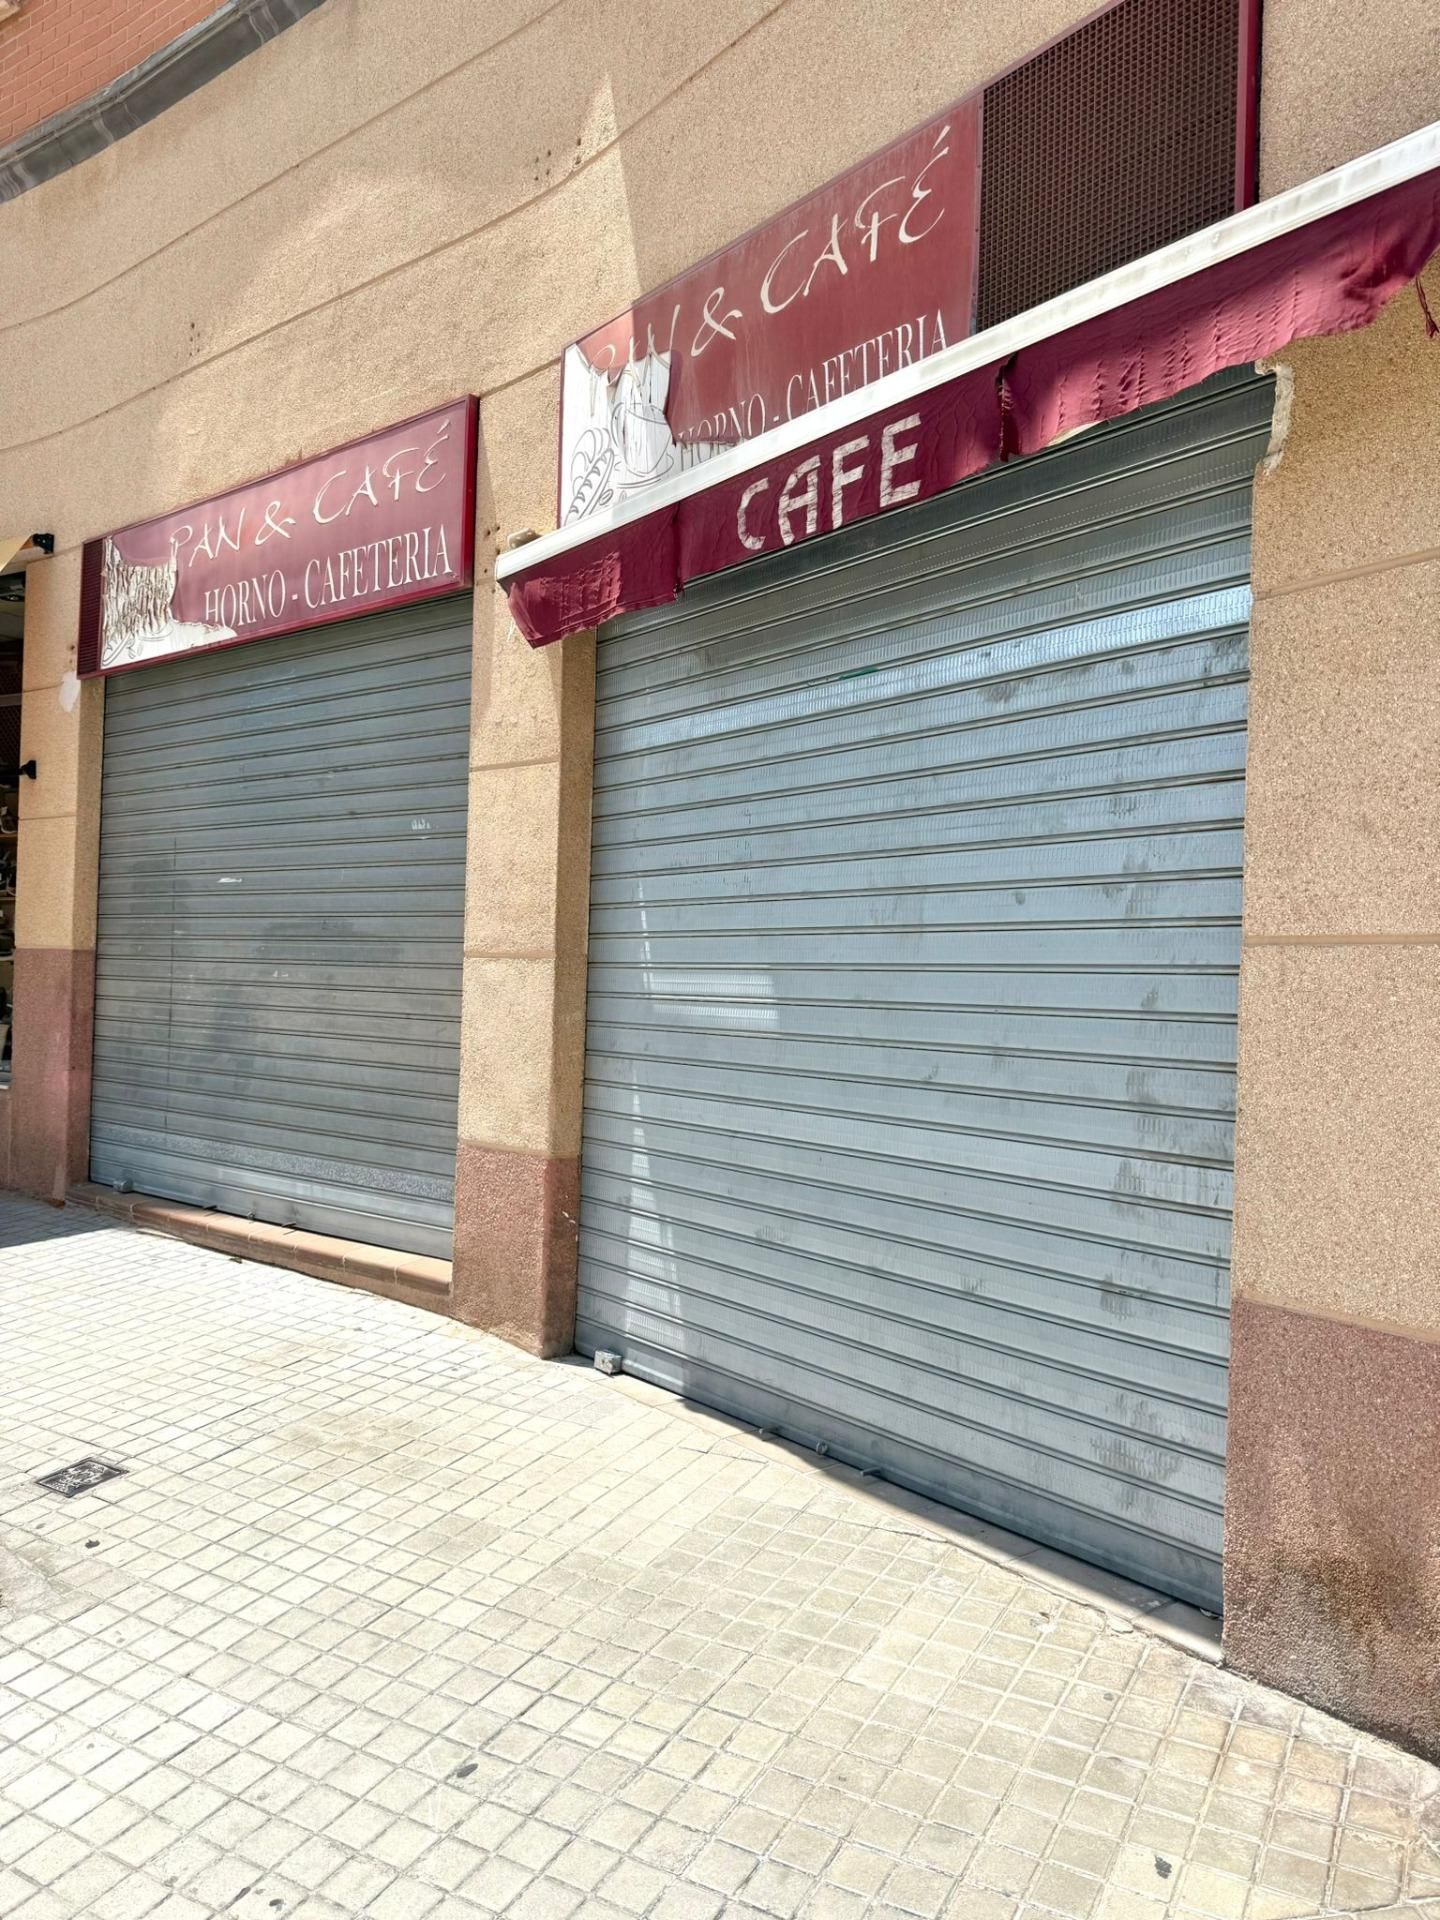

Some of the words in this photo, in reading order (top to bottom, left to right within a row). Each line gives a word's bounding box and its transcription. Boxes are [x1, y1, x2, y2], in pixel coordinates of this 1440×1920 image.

[690, 286, 744, 358] &
[760, 125, 951, 314] CAFÉ
[786, 308, 948, 421] CAFETERIA
[169, 507, 246, 567] PAN
[254, 500, 297, 546] &
[313, 418, 451, 525] CAFÉ
[736, 412, 923, 551] CAFE
[204, 569, 286, 628] HORNO
[304, 523, 454, 609] CAFETERIA
